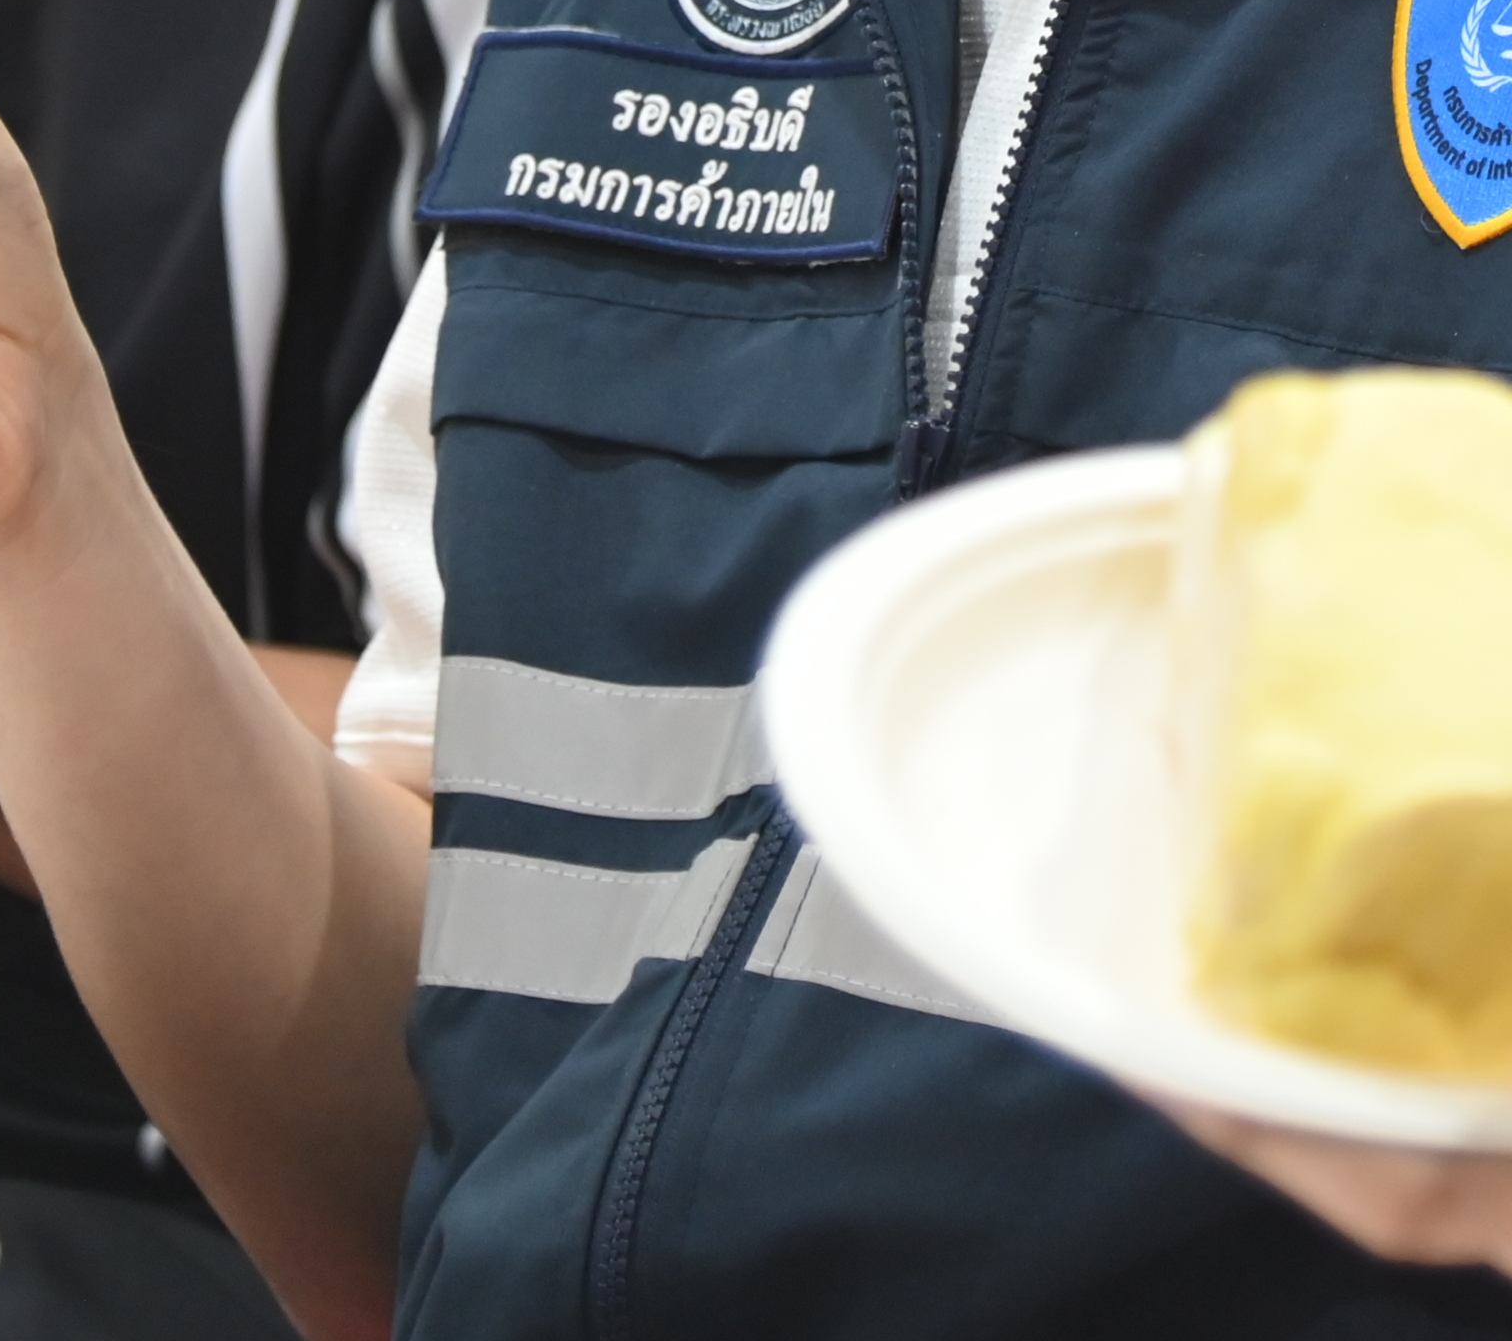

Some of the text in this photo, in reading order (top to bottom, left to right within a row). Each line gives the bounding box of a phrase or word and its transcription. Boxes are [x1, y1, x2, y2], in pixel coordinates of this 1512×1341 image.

[612, 84, 816, 153] รองอธิบดี
[1411, 58, 1467, 170] Department
[1465, 157, 1488, 179] of
[503, 154, 835, 236] กรมการค้าภายใน
